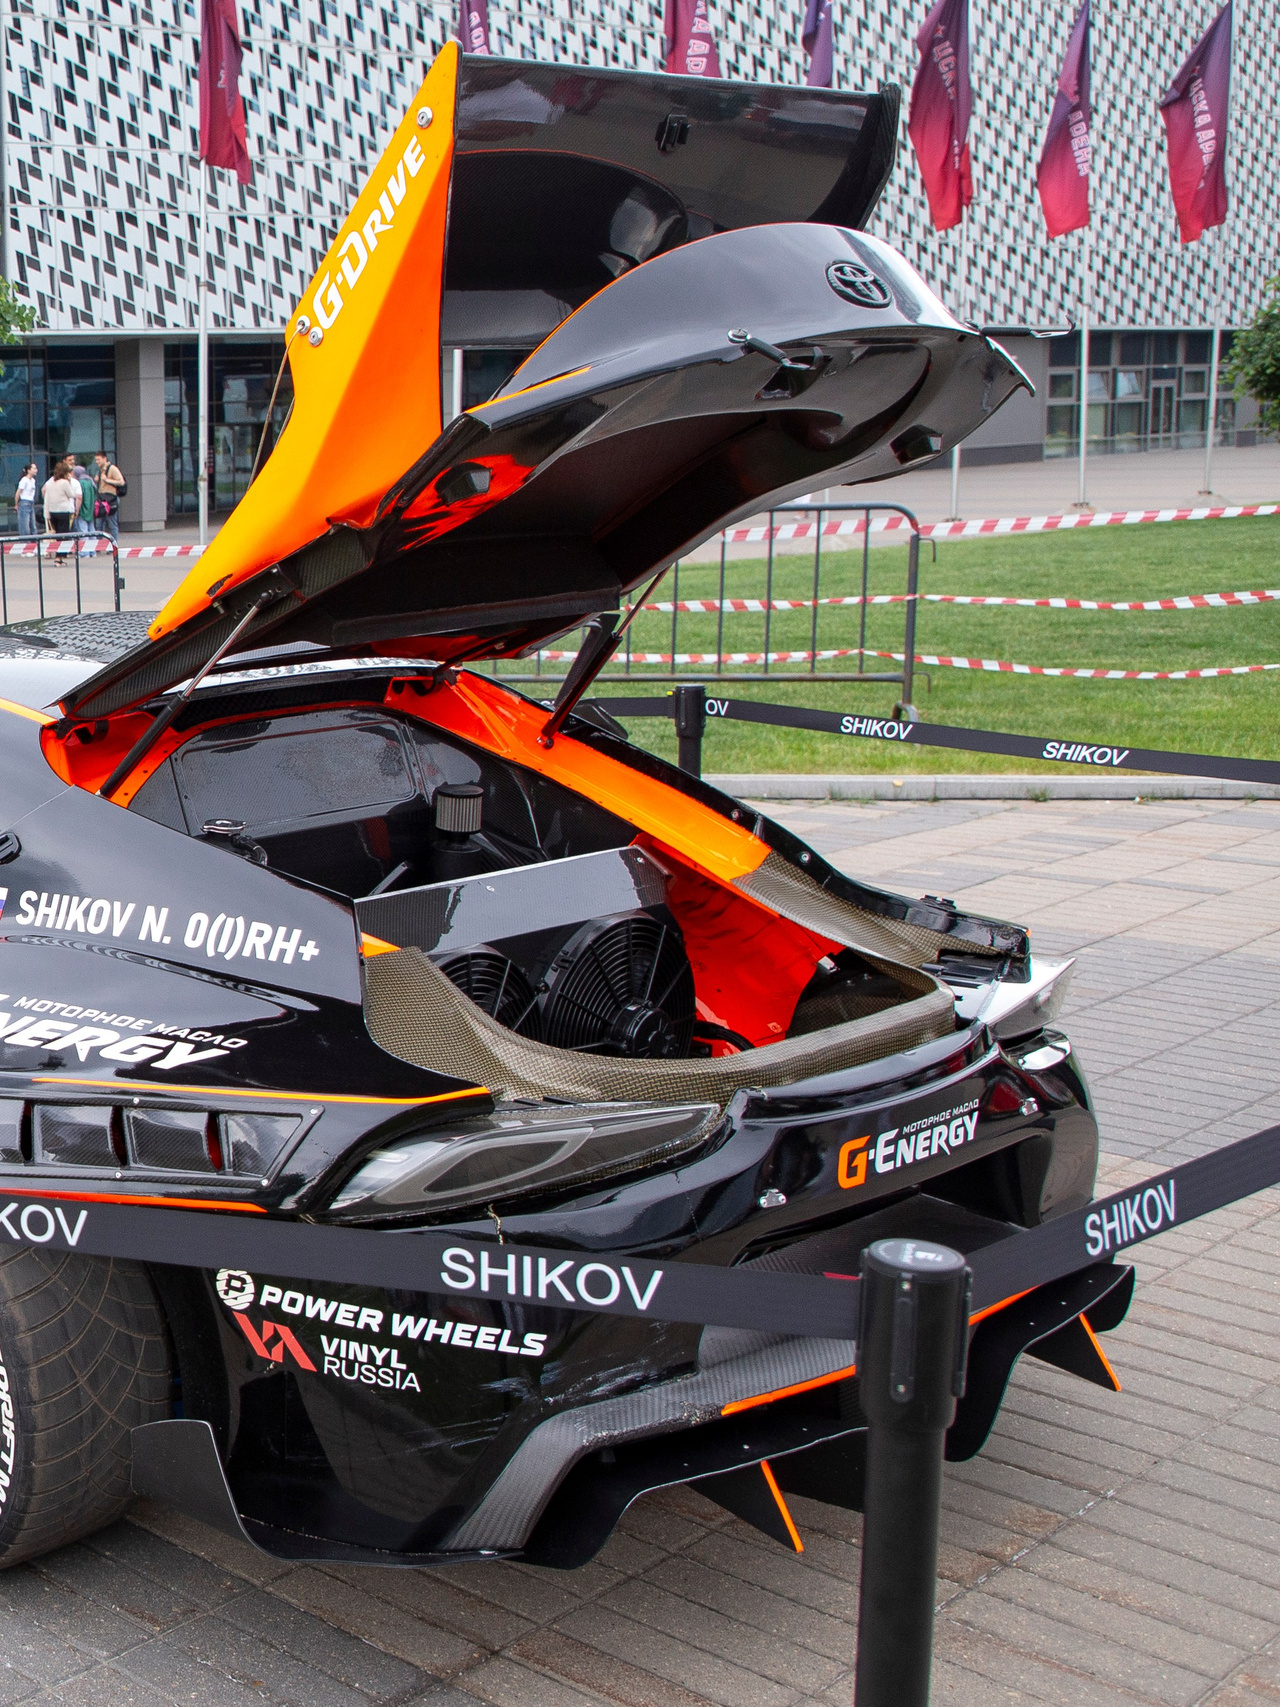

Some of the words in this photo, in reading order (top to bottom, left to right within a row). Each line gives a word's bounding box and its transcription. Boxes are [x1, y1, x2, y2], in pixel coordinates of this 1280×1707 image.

[840, 715, 913, 740] SHIKOV
[1042, 741, 1129, 766] SHIKOV
[15, 890, 136, 937] SHIKOV
[138, 905, 171, 945] N.
[12, 995, 153, 1031] МОТОРНОЕ
[150, 1022, 249, 1049] МАСЛО
[902, 1109, 952, 1135] МОТОРНОЕ
[952, 1098, 980, 1117] МАСЛО
[1084, 1179, 1176, 1257] SHIKOV
[440, 1246, 663, 1311] SHIKOV
[260, 1285, 383, 1333] POWER
[391, 1313, 548, 1357] WHEELS
[320, 1335, 408, 1370] VINYL
[323, 1356, 421, 1393] RUSSIA
